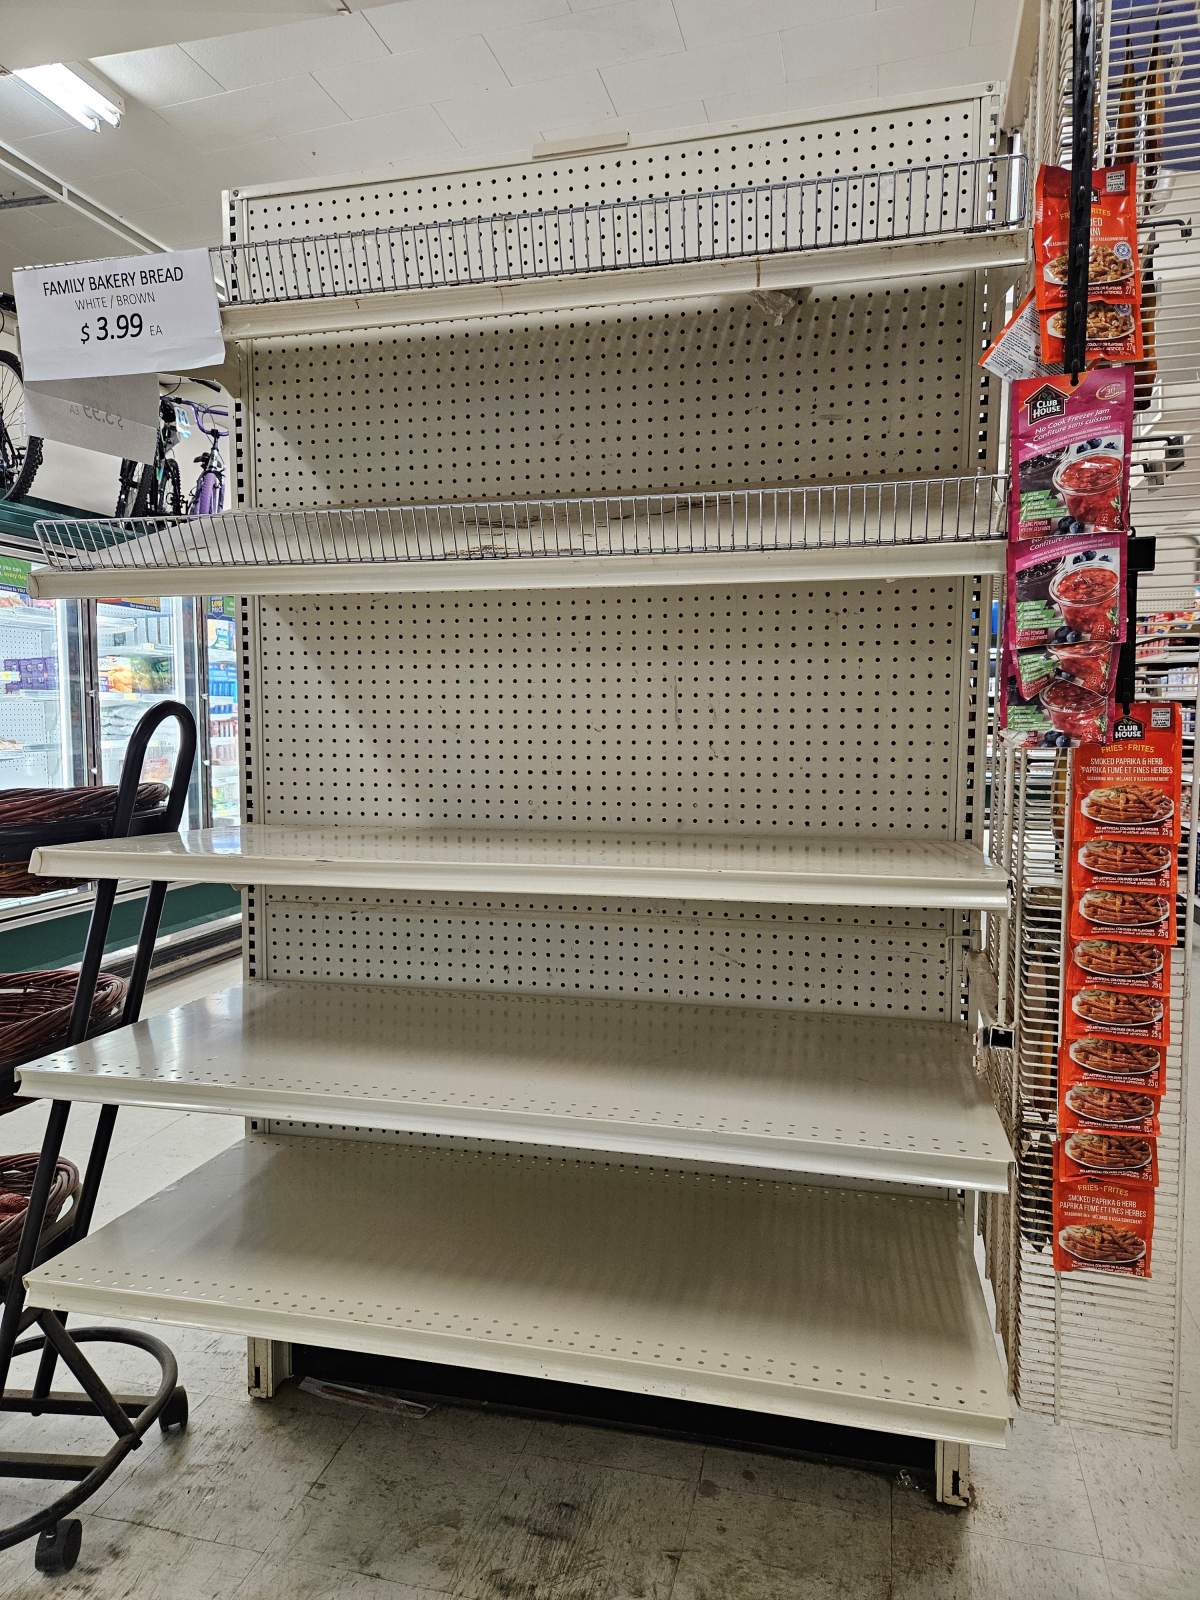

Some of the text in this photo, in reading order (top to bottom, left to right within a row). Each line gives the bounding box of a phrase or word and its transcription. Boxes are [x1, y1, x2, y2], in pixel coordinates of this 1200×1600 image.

[43, 266, 184, 297] FAMILY BAKERY BREAD
[75, 297, 108, 311] WHITE
[116, 292, 156, 306] BROWN
[80, 312, 164, 344] $ 3.99 EA
[1036, 400, 1058, 408] CLUB
[1032, 406, 1061, 418] HOUSE
[1035, 408, 1110, 435] No Cook Freezer Jam
[1033, 426, 1066, 442] Confiture
[1085, 416, 1112, 425] cuisson
[1101, 744, 1123, 753] FRIES
[1128, 744, 1155, 753] FRITES
[1158, 929, 1165, 937] 25
[1103, 1185, 1129, 1196] FRITES
[1068, 1194, 1091, 1203] SMOKED
[1092, 1197, 1116, 1206] PAPRIKA
[1060, 1202, 1083, 1210] PAPRIKA
[1124, 1209, 1146, 1218] HERBES
